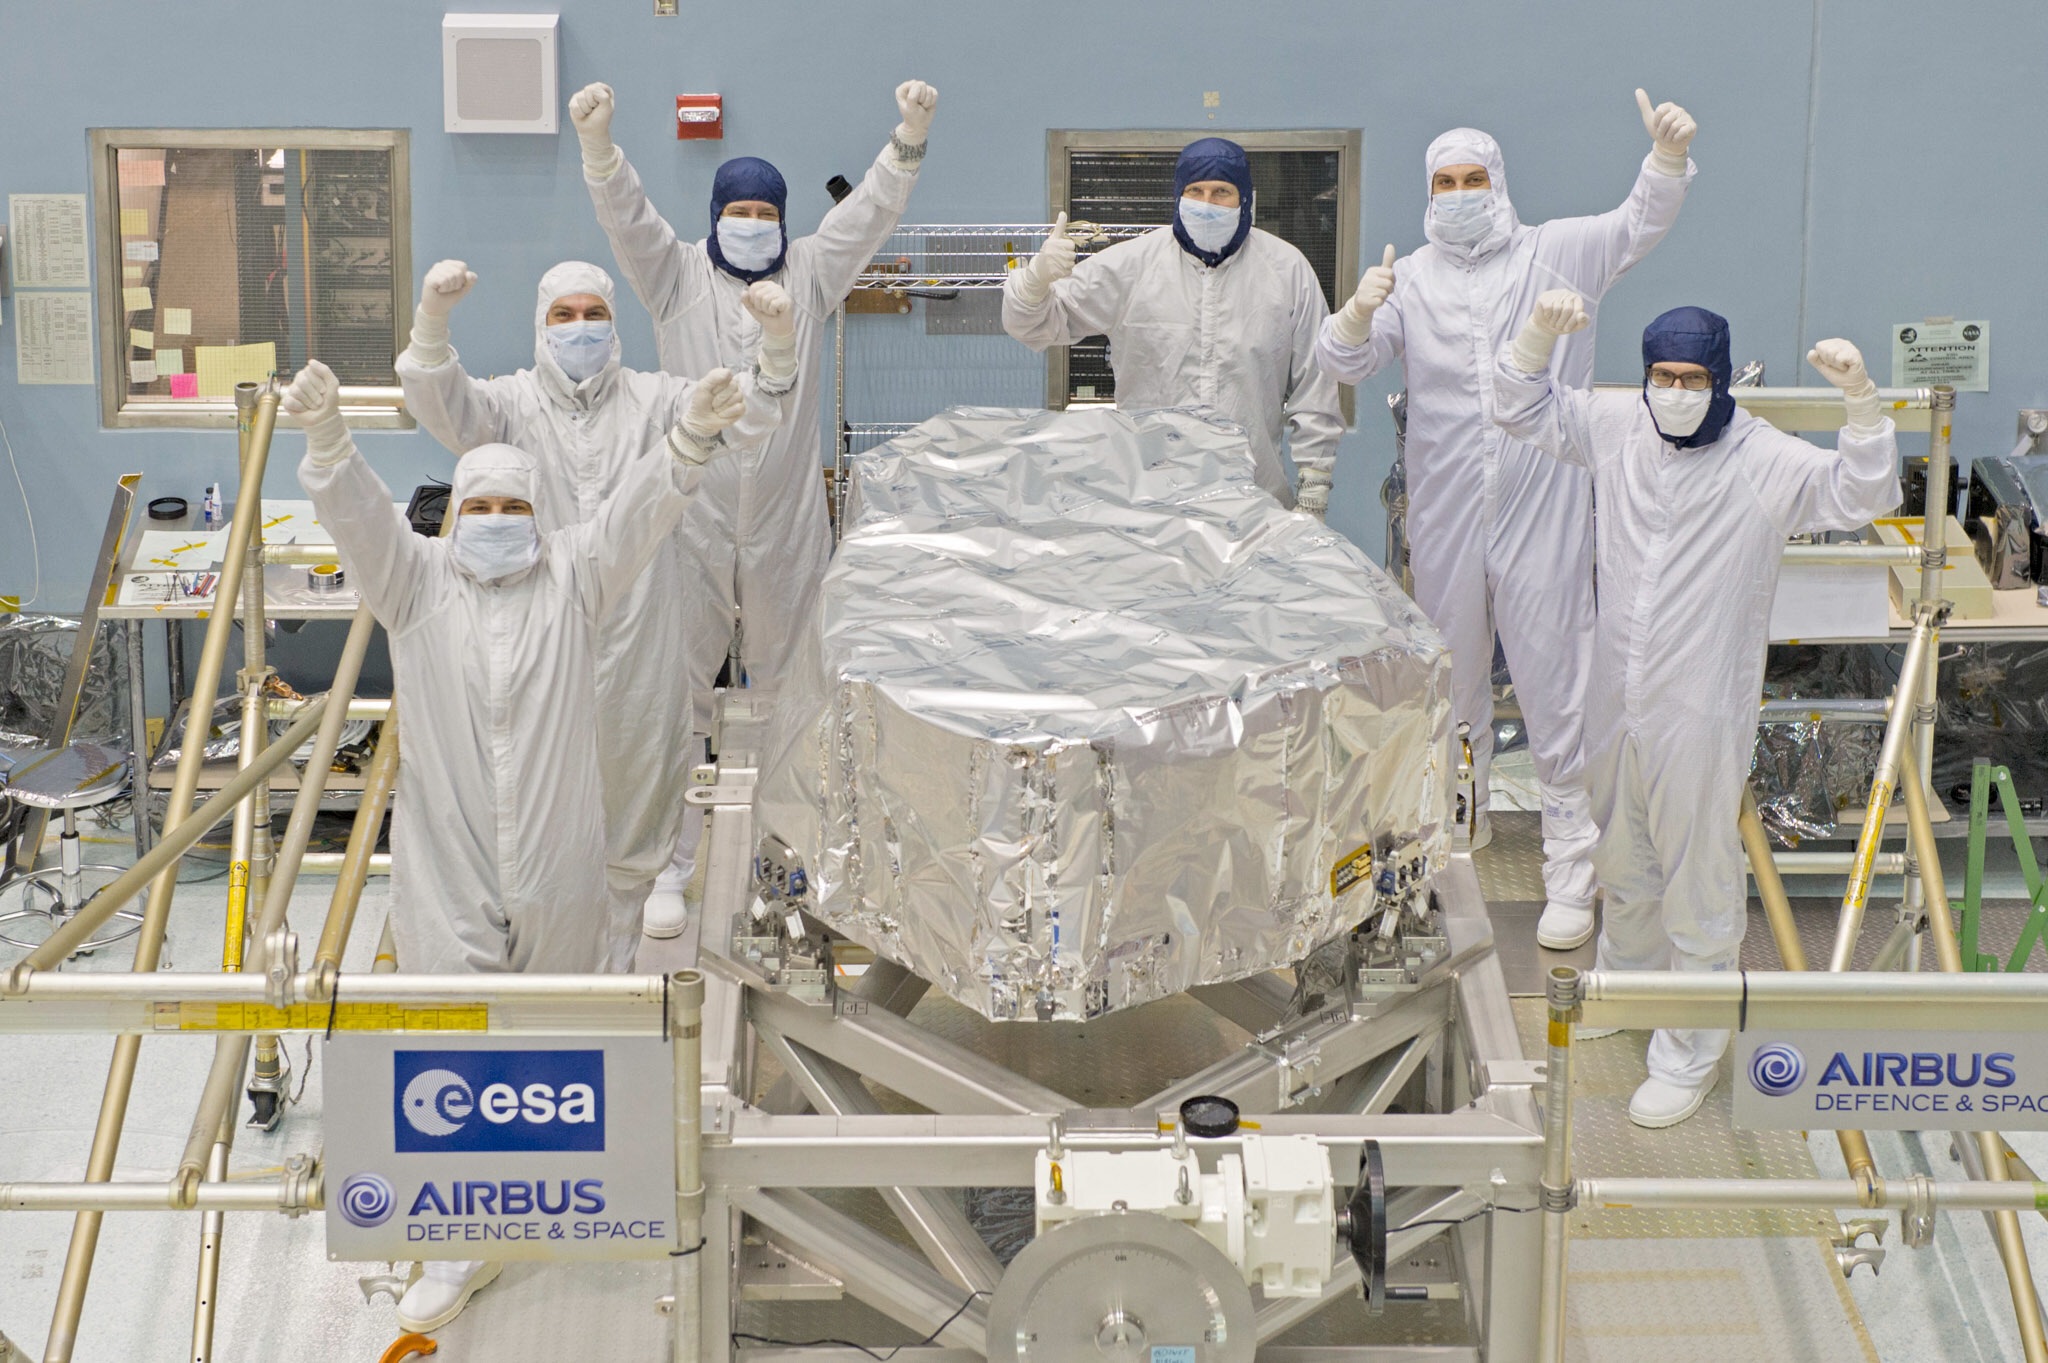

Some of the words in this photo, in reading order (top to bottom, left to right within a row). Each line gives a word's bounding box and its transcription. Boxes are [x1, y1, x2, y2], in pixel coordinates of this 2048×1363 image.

[1817, 1052, 2016, 1088] AIRBUS
[479, 1083, 596, 1124] esa
[1815, 1094, 1949, 1112] DEFENCE
[1956, 1094, 1974, 1112] &
[408, 1178, 606, 1216] AIRBUS
[408, 1222, 541, 1241] DEFENCE
[547, 1222, 566, 1240] &
[574, 1221, 665, 1240] SPACE
